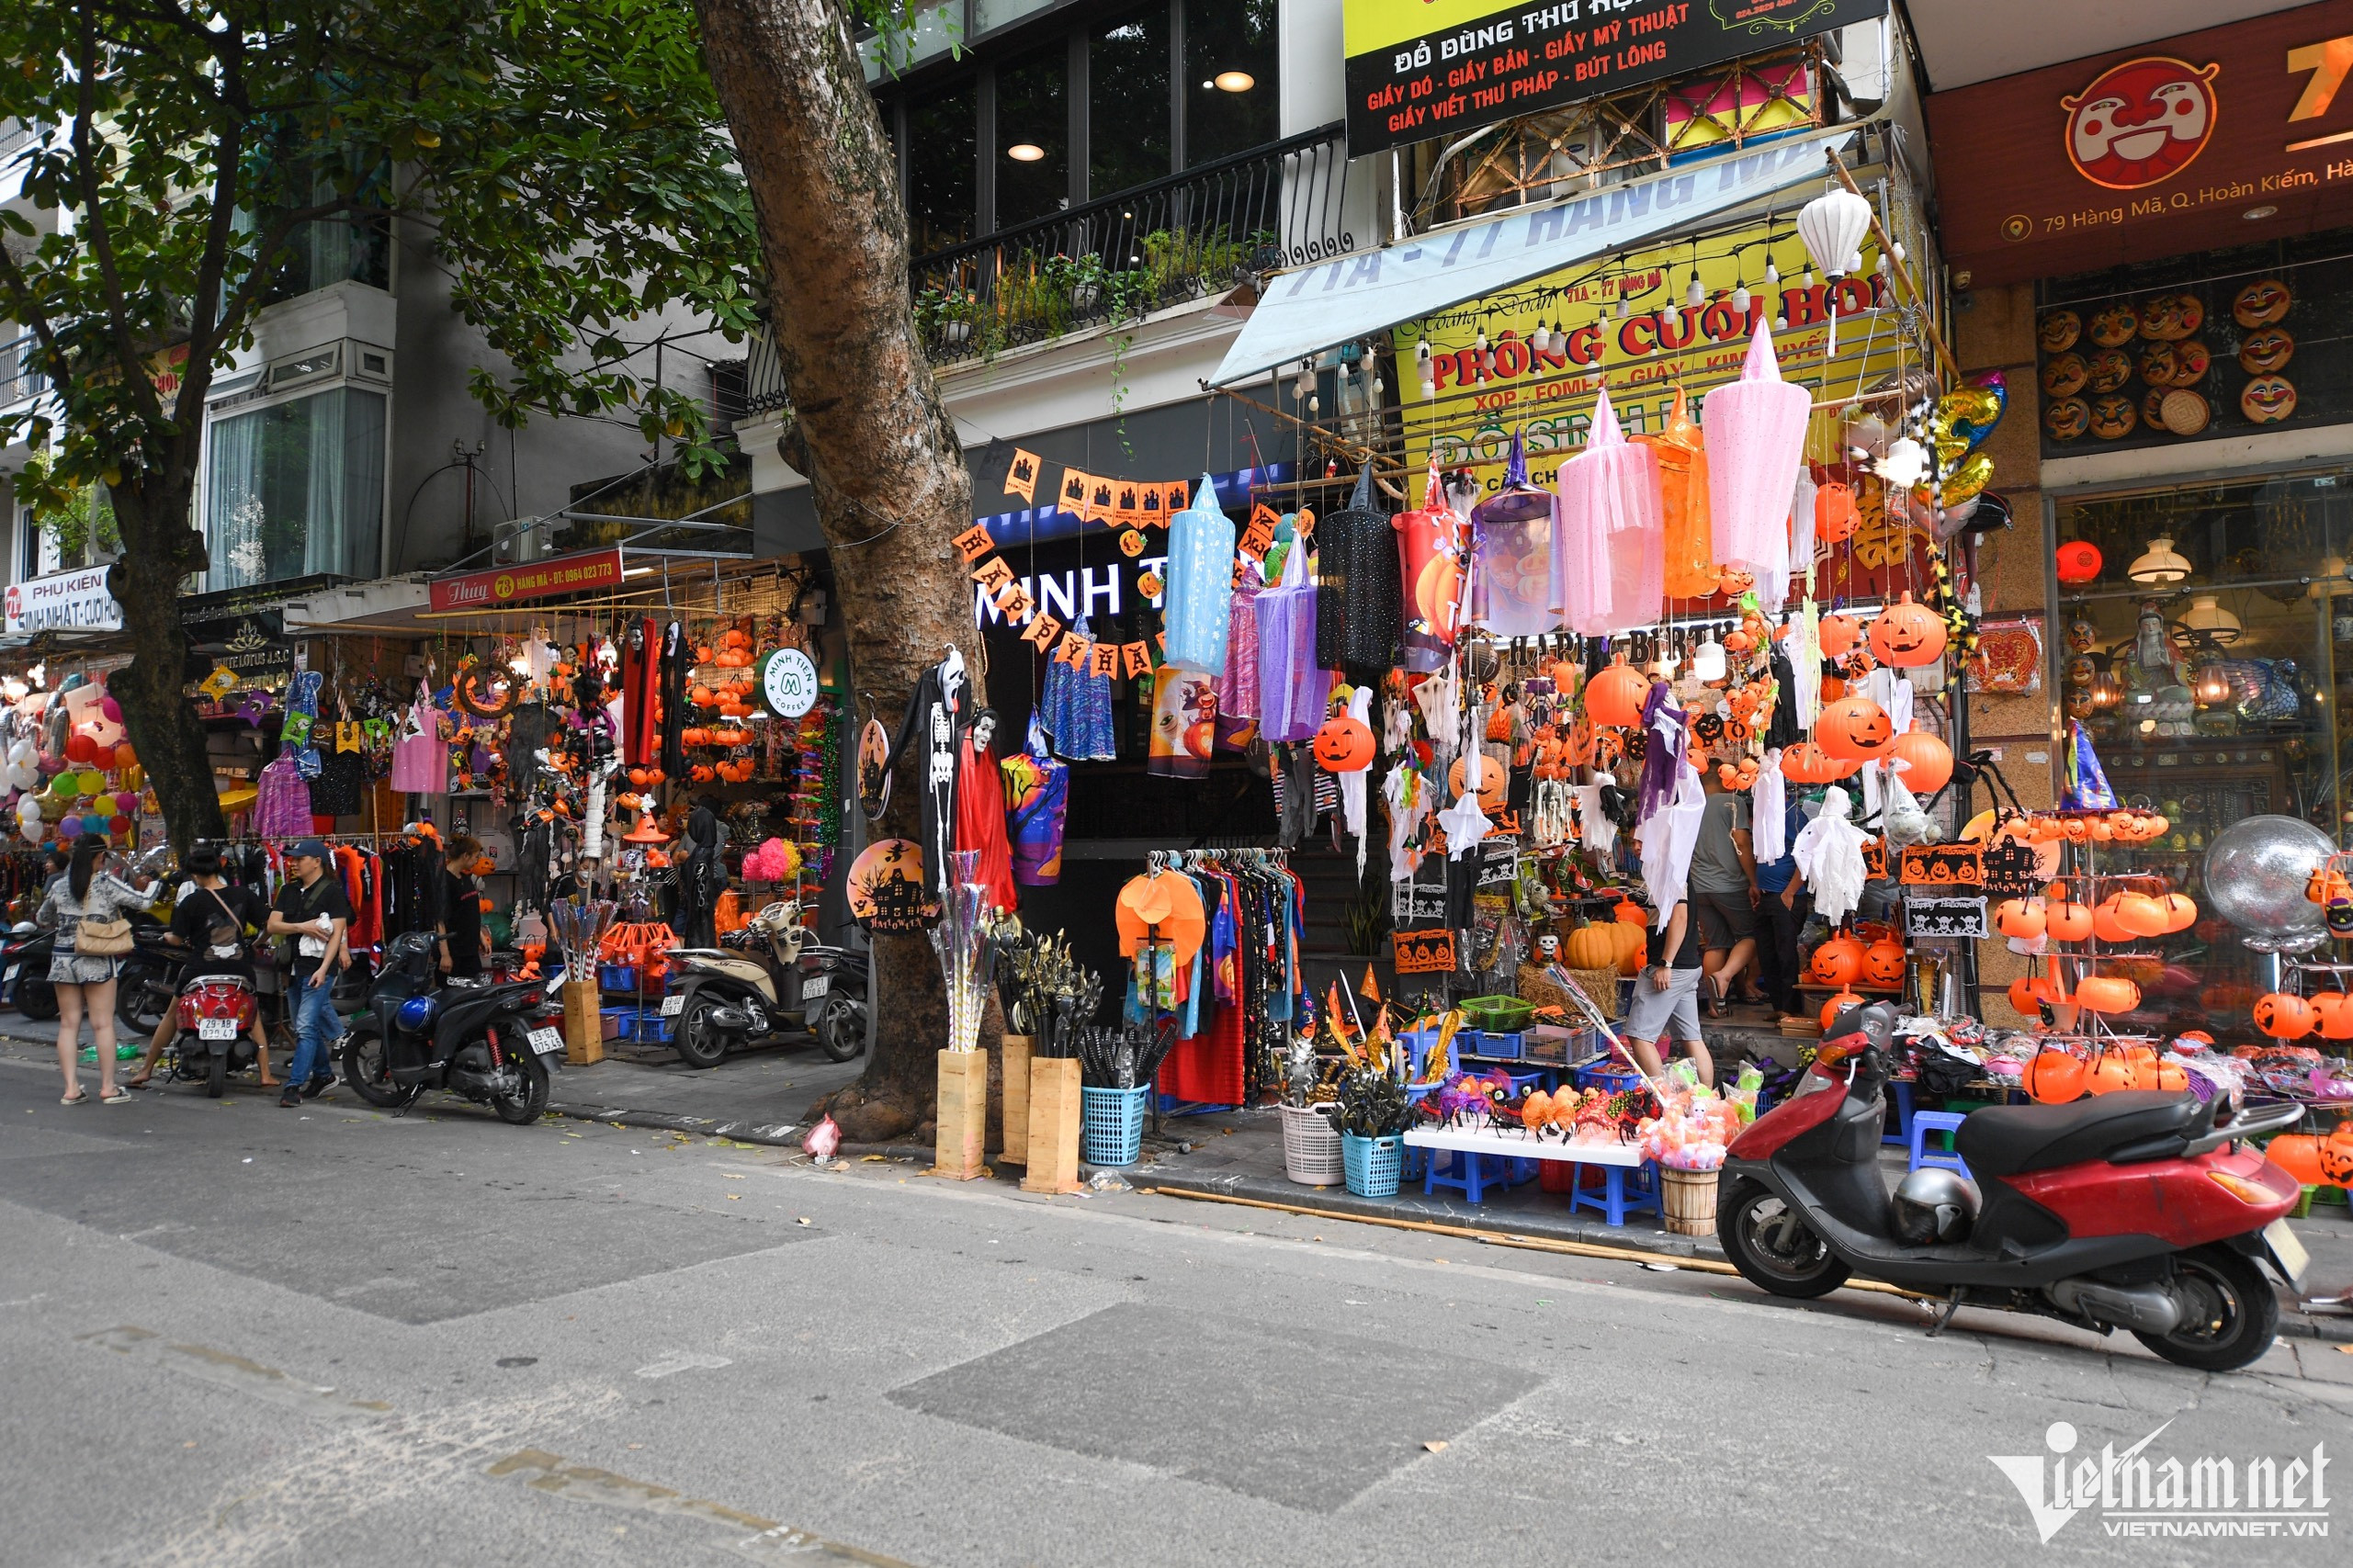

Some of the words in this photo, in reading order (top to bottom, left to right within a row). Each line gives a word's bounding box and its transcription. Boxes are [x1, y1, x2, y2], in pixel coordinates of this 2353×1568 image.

[1367, 83, 1405, 110] GIẤY
[1410, 74, 1432, 99] DÓ
[1448, 59, 1488, 89] GIẤY
[1493, 48, 1529, 76] BẢN
[1545, 29, 1588, 60] GIẤY
[1593, 19, 1623, 47] MỸ
[1627, 3, 1690, 37] THUẬT
[1395, 39, 1431, 73] ĐỒ
[1441, 20, 1513, 61] DÙNG
[1388, 105, 1426, 132] GIẤY
[1431, 93, 1467, 120] VIẾT
[1472, 83, 1505, 109] THƯ
[1511, 70, 1559, 99] PHÁP
[1575, 55, 1611, 82] BÚT
[1617, 40, 1667, 71] LÔNG
[2042, 215, 2066, 233] 79
[2072, 201, 2123, 228] Hàng
[2132, 197, 2166, 217] Mã,
[2171, 192, 2194, 208] Q.
[2199, 181, 2254, 203] Hoàn
[2261, 169, 2319, 192] Kiếm,
[1567, 285, 1589, 303] 71A
[33, 582, 63, 600] PHỤ
[67, 574, 101, 592] KIỆN
[447, 581, 489, 603] Thúy
[497, 581, 513, 593] 73
[516, 575, 535, 590] HÀNG
[565, 568, 583, 582] 0964
[583, 566, 597, 579] 023
[598, 562, 612, 577] 773
[239, 652, 266, 668] LOTUS
[769, 655, 792, 678] MINH
[797, 657, 813, 682] TIEN
[776, 697, 806, 711] COFFEE
[870, 918, 922, 931] HALLOWEEN
